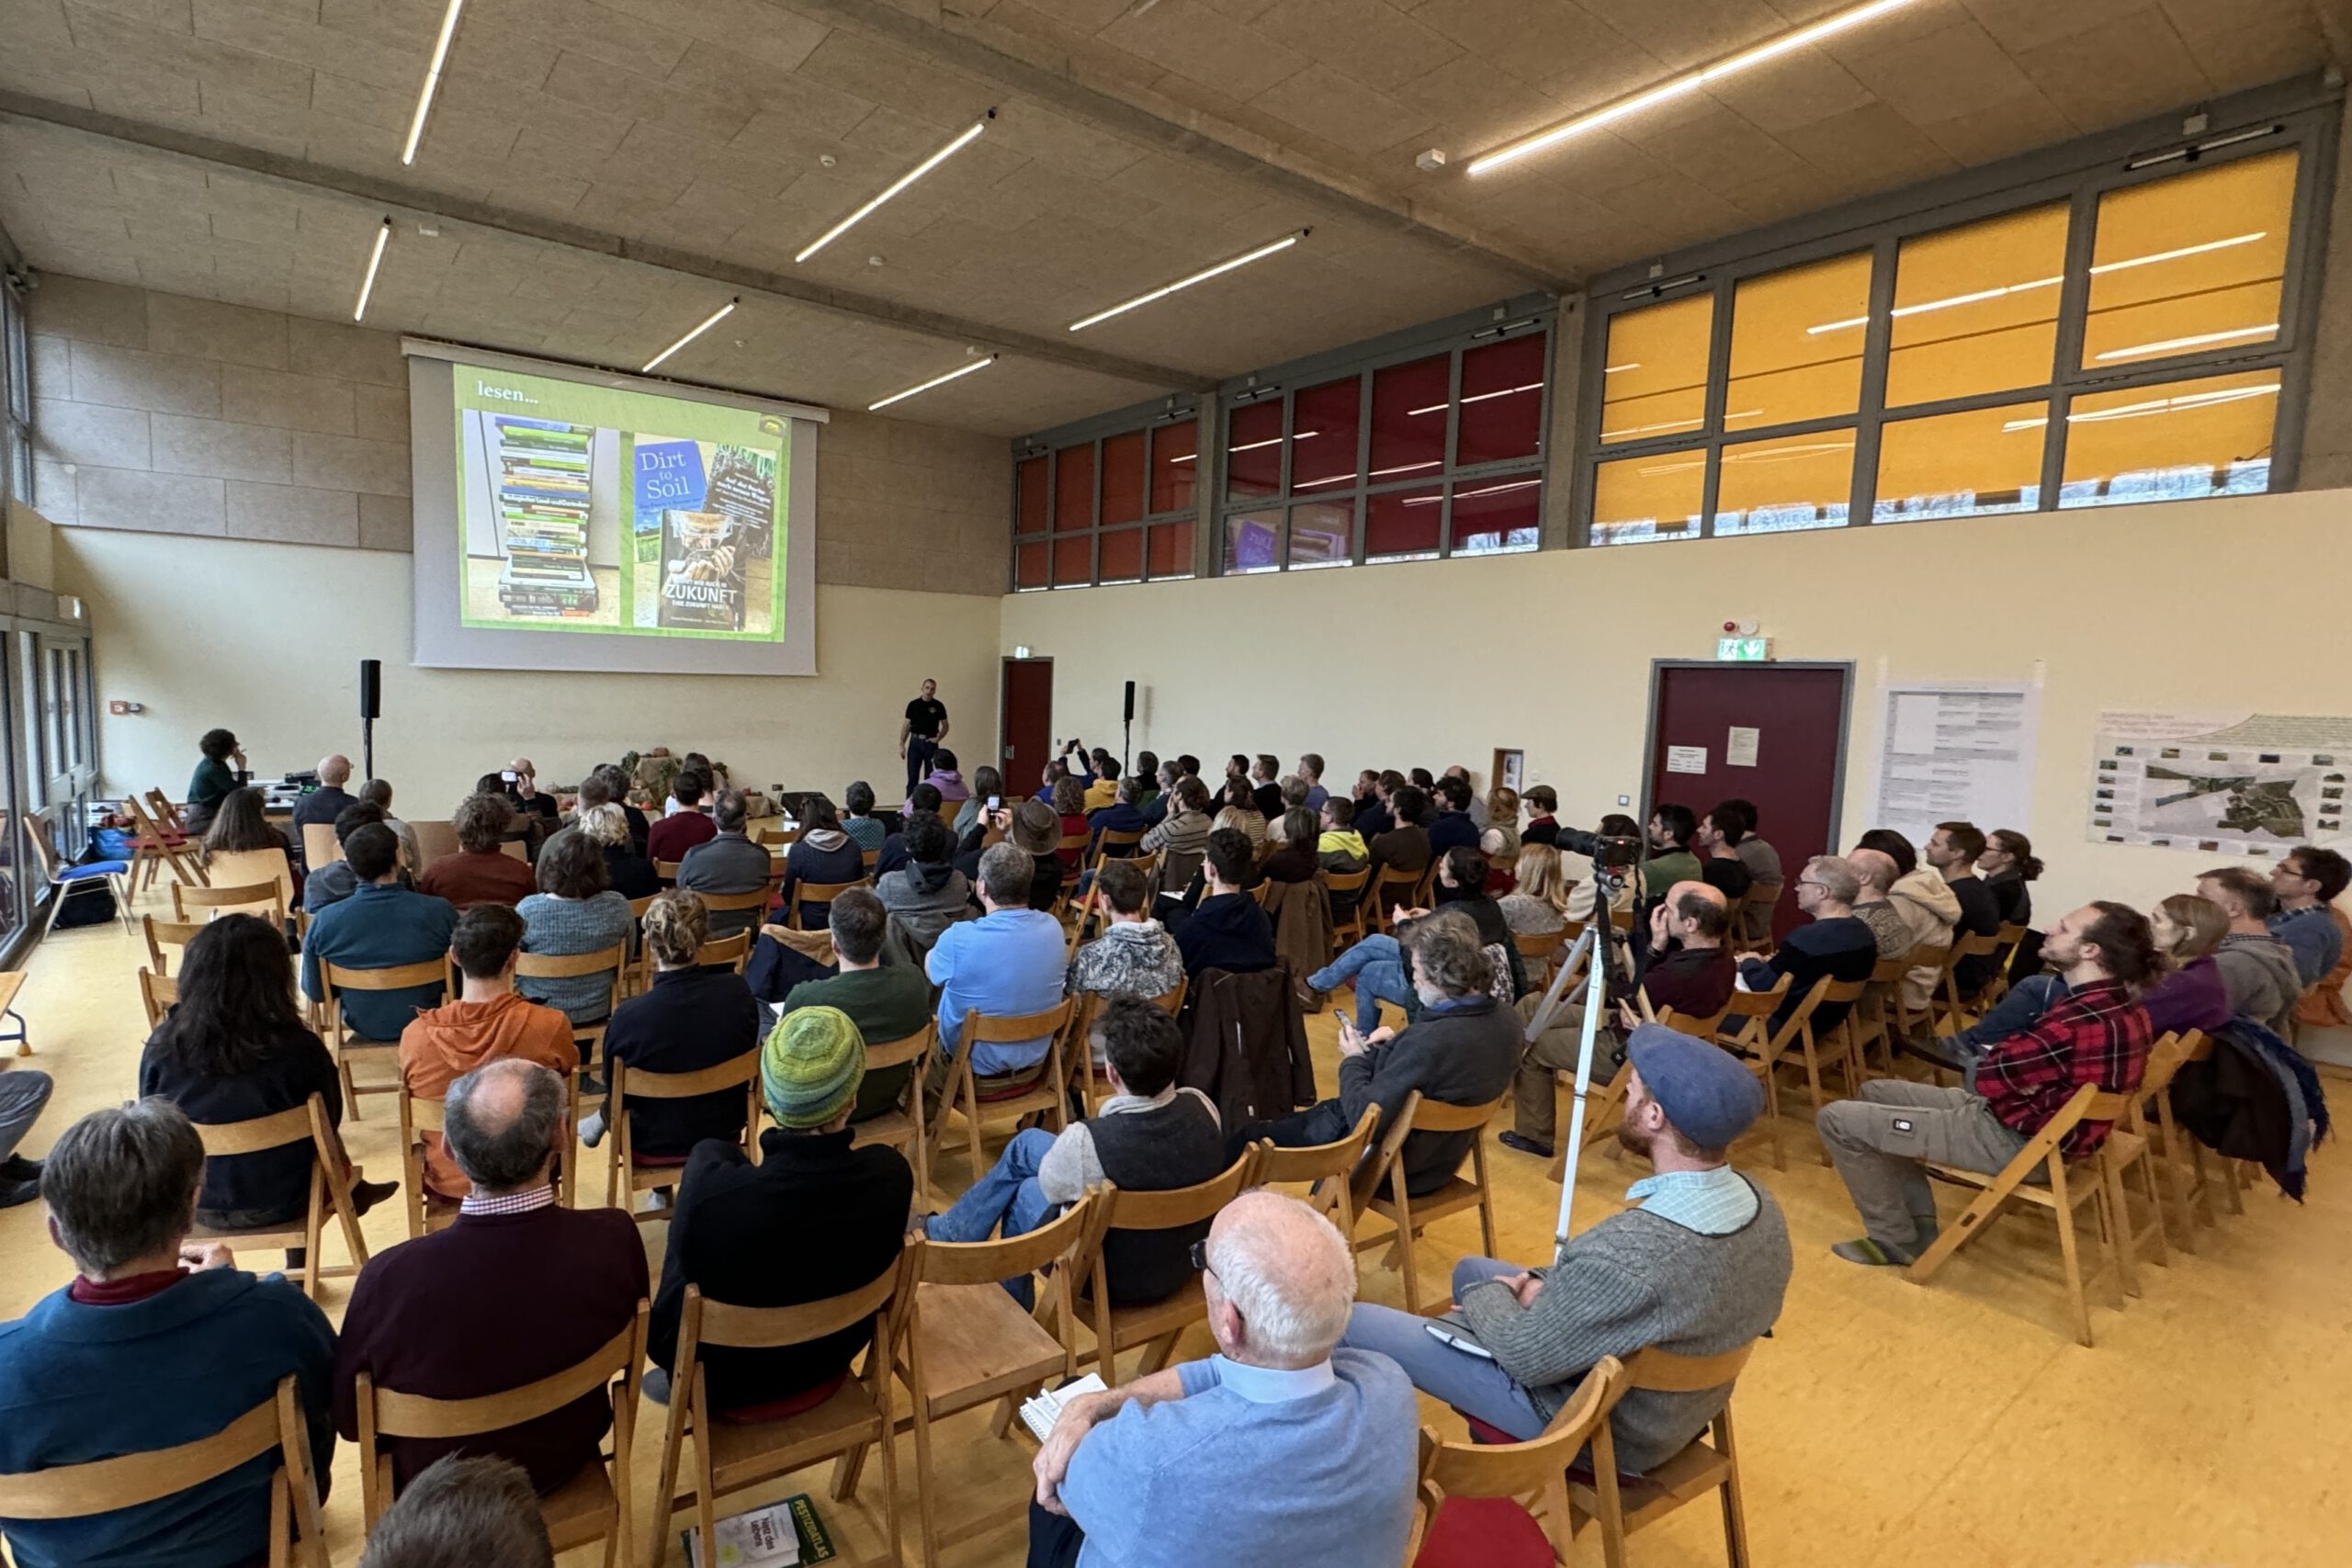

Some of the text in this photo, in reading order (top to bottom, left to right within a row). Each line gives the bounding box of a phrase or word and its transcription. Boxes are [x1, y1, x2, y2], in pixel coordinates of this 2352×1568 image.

[477, 380, 539, 404] lesen...
[639, 451, 686, 471] Dirt
[659, 470, 673, 480] to
[646, 476, 691, 500] Soil
[665, 583, 738, 604] ZUKUNFT
